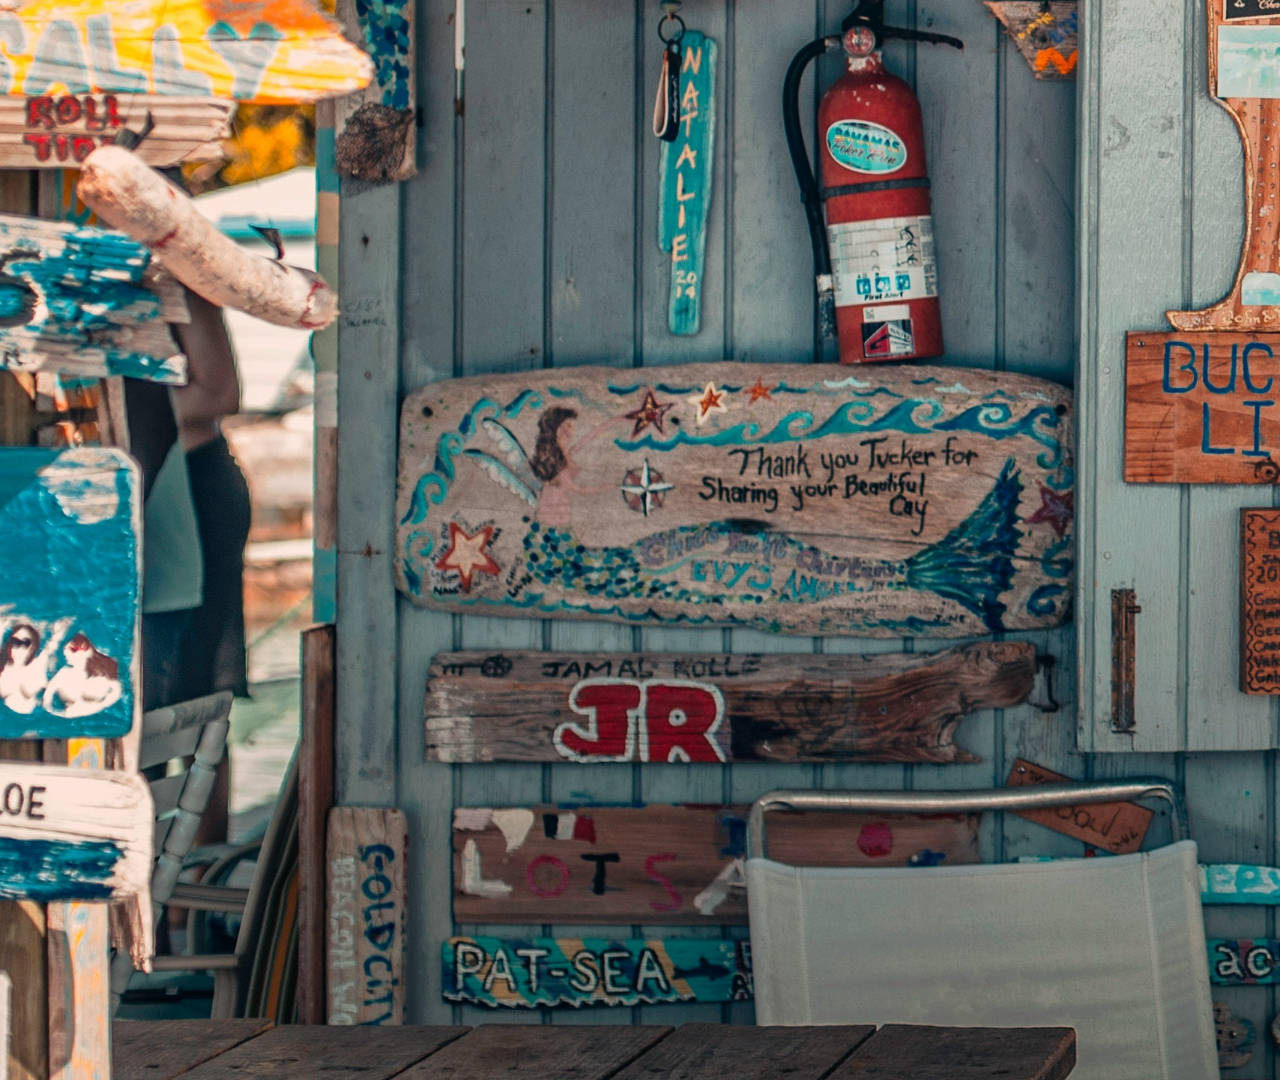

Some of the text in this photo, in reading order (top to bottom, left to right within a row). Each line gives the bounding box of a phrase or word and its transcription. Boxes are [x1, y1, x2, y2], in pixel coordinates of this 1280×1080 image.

[834, 126, 901, 153] BAHAMAS
[729, 435, 979, 482] Thank you Tucker for
[700, 473, 927, 513] Sharing your Beautiful
[888, 492, 930, 537] Cay
[553, 678, 728, 762] JR
[453, 941, 672, 995] PAT-SEA
